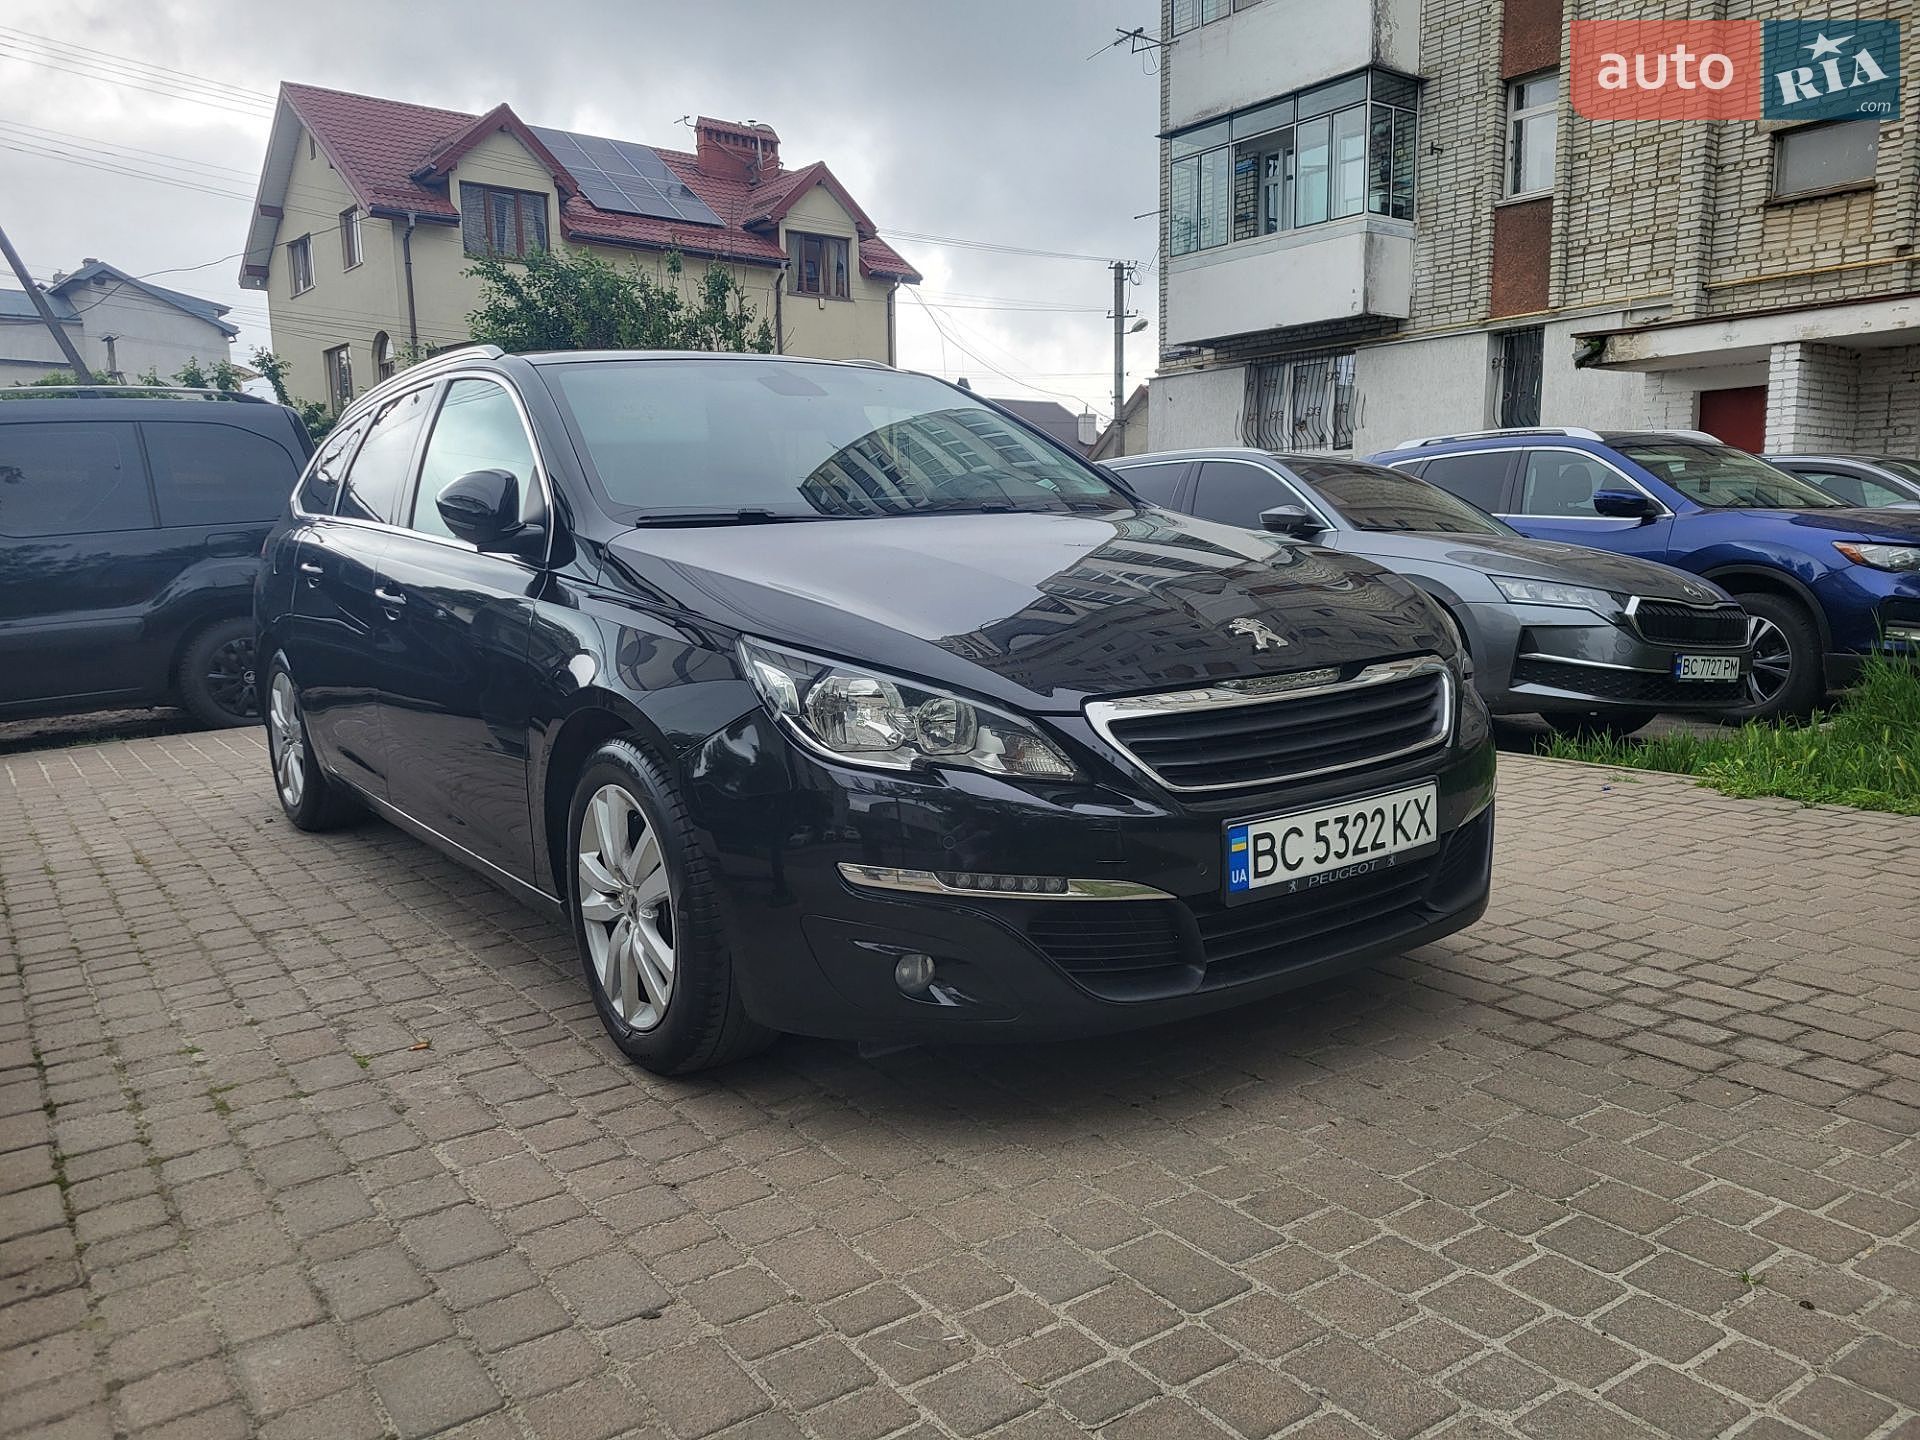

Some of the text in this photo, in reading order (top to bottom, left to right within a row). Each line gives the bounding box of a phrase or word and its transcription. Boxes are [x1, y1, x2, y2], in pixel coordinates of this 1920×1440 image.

[1683, 658, 1738, 677] BC 7727 PM
[1253, 794, 1432, 879] BC 5322 KX
[1231, 868, 1247, 884] UA
[1308, 859, 1380, 888] PEUGEOT
